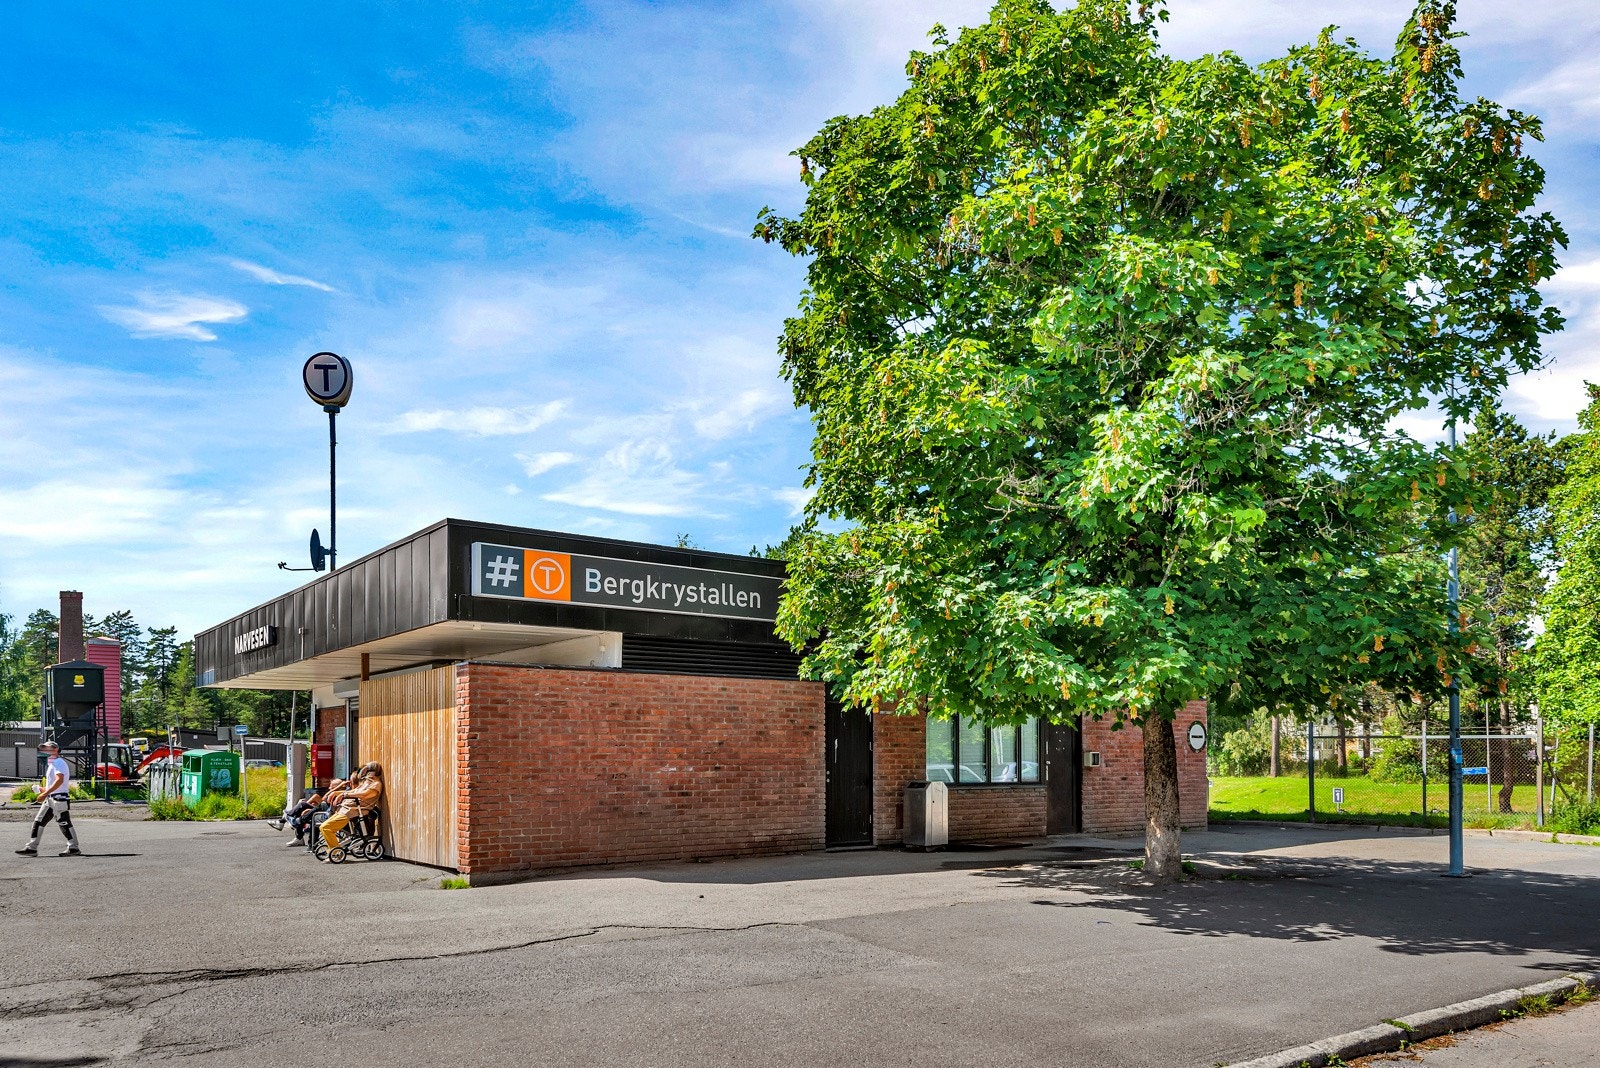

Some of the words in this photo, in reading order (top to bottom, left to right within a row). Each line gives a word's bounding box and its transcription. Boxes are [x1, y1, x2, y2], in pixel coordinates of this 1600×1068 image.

[314, 364, 337, 392] T
[539, 566, 556, 590] T
[585, 568, 761, 609] Bergkrystallen
[234, 624, 268, 655] NARVESEN
